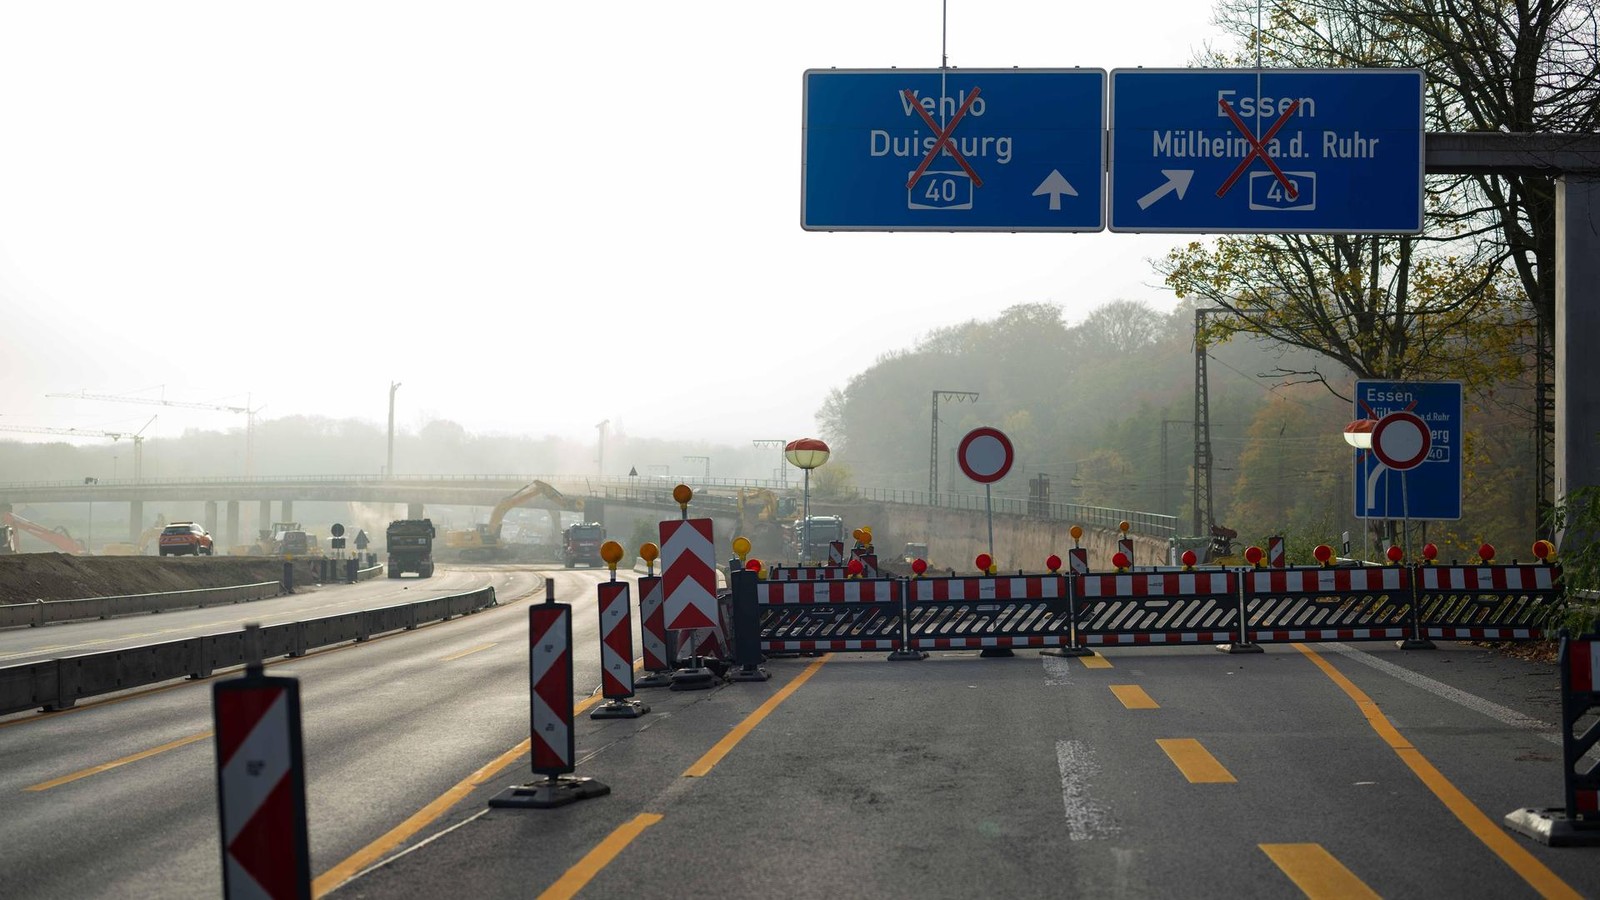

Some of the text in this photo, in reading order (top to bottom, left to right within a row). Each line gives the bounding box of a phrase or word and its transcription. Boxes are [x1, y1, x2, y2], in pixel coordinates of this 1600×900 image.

[899, 89, 986, 117] Venlo
[1217, 90, 1315, 117] Essen
[870, 129, 1013, 164] Duisburg
[1153, 130, 1379, 158] Mülheim a.d. Ruhr
[925, 179, 956, 202] 40
[1266, 179, 1300, 202] 40
[1367, 388, 1413, 402] Essen
